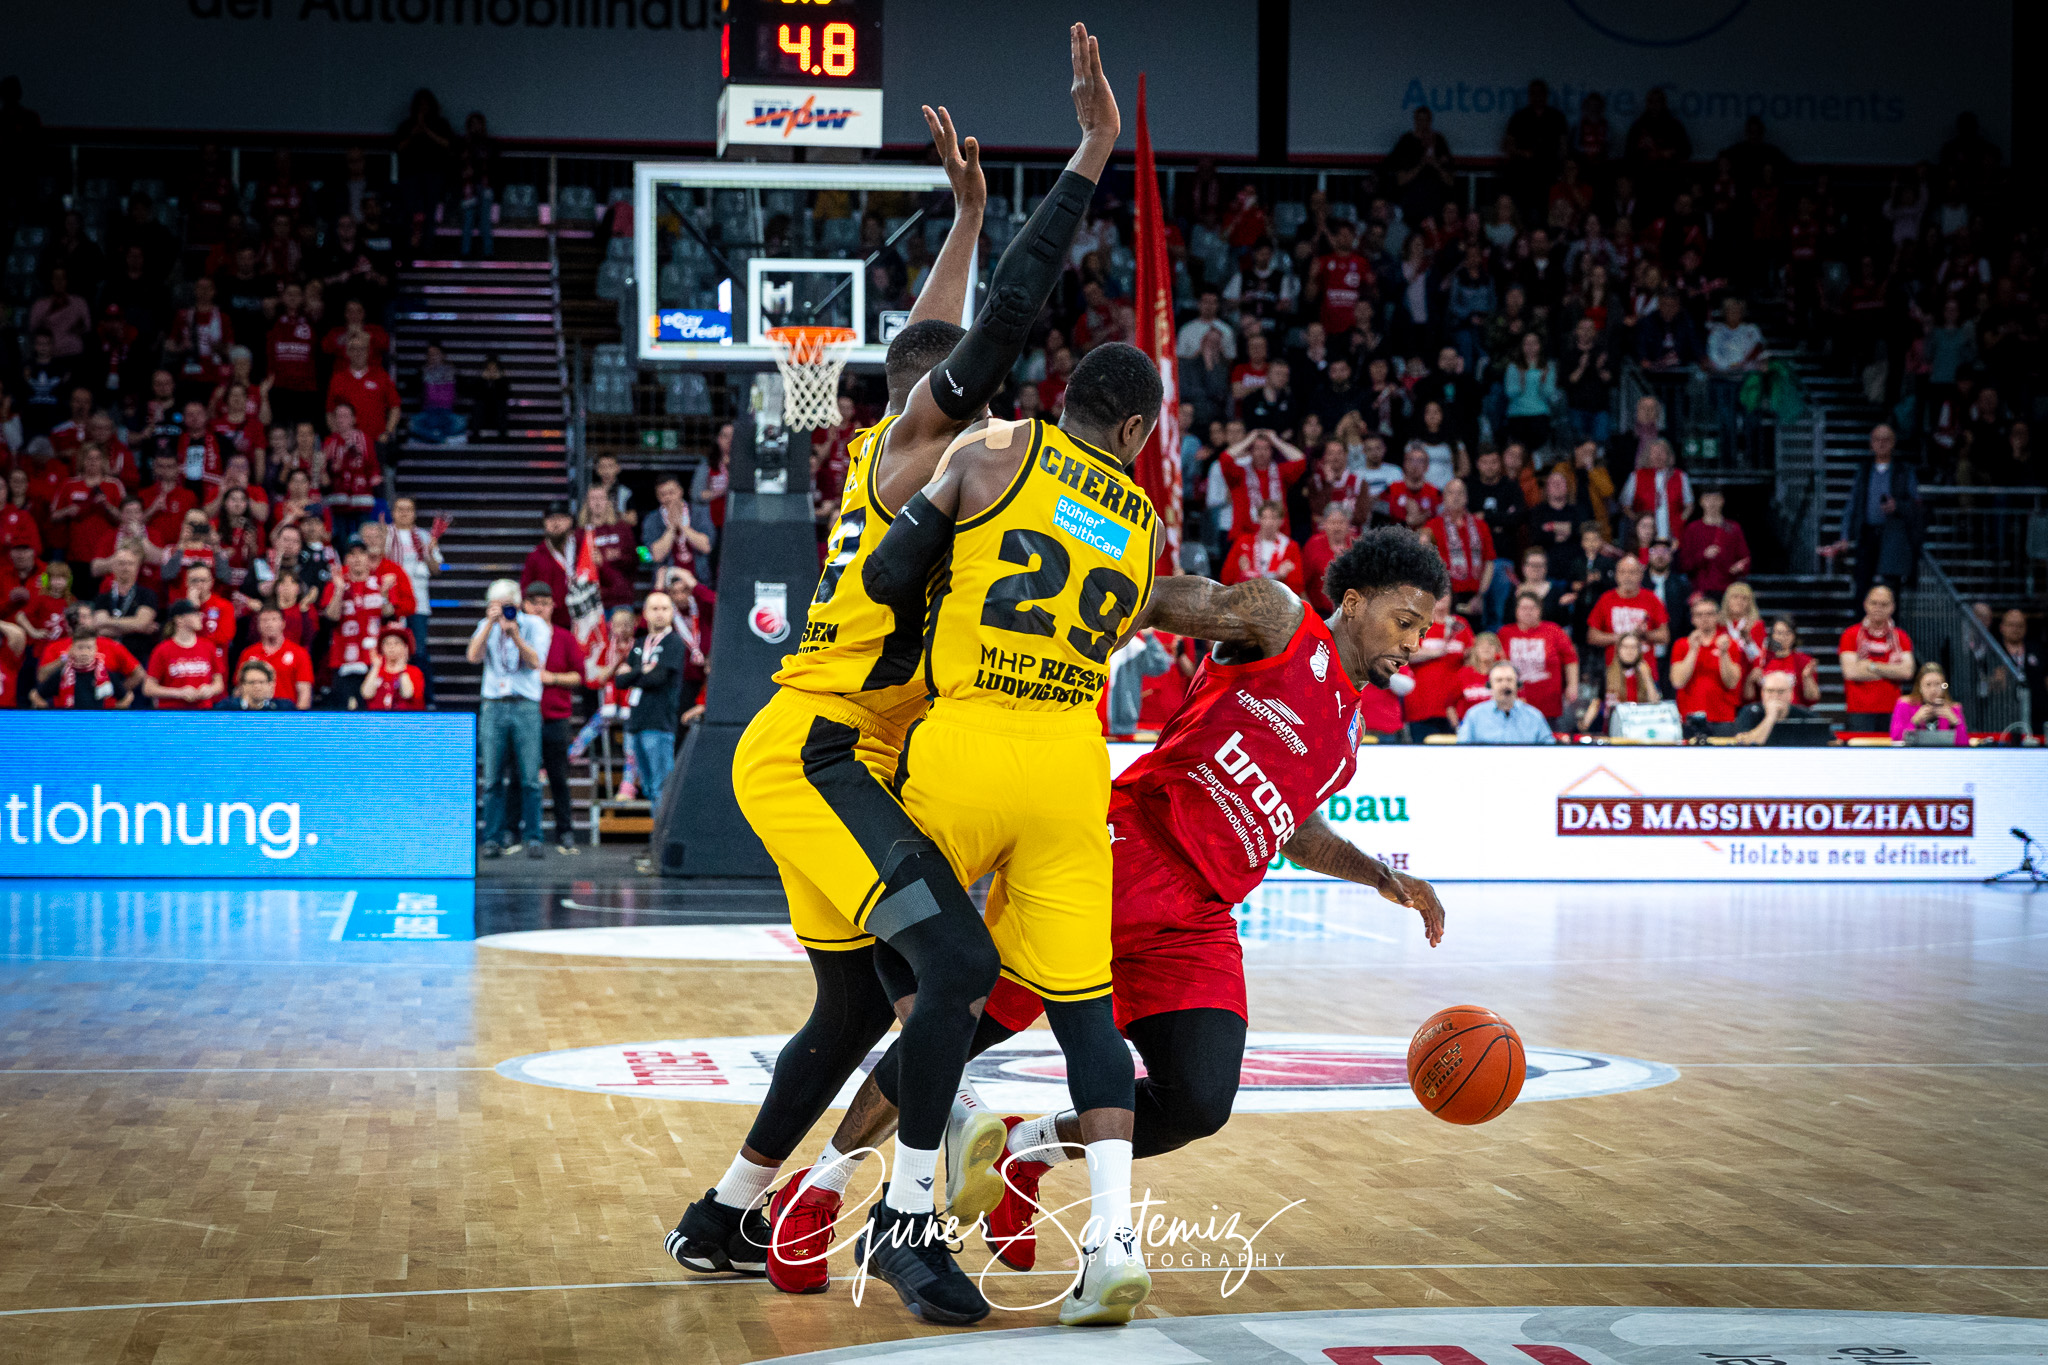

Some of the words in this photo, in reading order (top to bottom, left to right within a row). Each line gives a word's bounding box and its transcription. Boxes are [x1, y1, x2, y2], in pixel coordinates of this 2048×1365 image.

[778, 22, 855, 76] 4.8
[1040, 446, 1152, 531] CHERRY
[1057, 499, 1100, 529] Bühler
[1054, 513, 1122, 558] HealthCare
[980, 529, 1139, 664] 29
[980, 644, 1036, 674] MHP
[1236, 689, 1308, 756] LINKINPARTNER
[1238, 699, 1263, 721] GLOBAL
[1268, 723, 1298, 754] LOGISTICS
[1196, 762, 1257, 828] Internationaler
[1252, 825, 1269, 859] Partner
[1214, 731, 1295, 851] brose
[1320, 793, 1410, 822] bau
[1561, 803, 1632, 830] DAS
[1642, 803, 1970, 831] MASSIVHOLZHAUS
[0, 784, 318, 860] tlohnung.
[1187, 770, 1207, 785] der
[1206, 786, 1259, 869] Automobilindustrie
[1730, 842, 1819, 865] Holzbau
[1828, 848, 1866, 865] neu
[1875, 842, 1976, 865] definiert.
[1420, 1043, 1462, 1096] LEGACY
